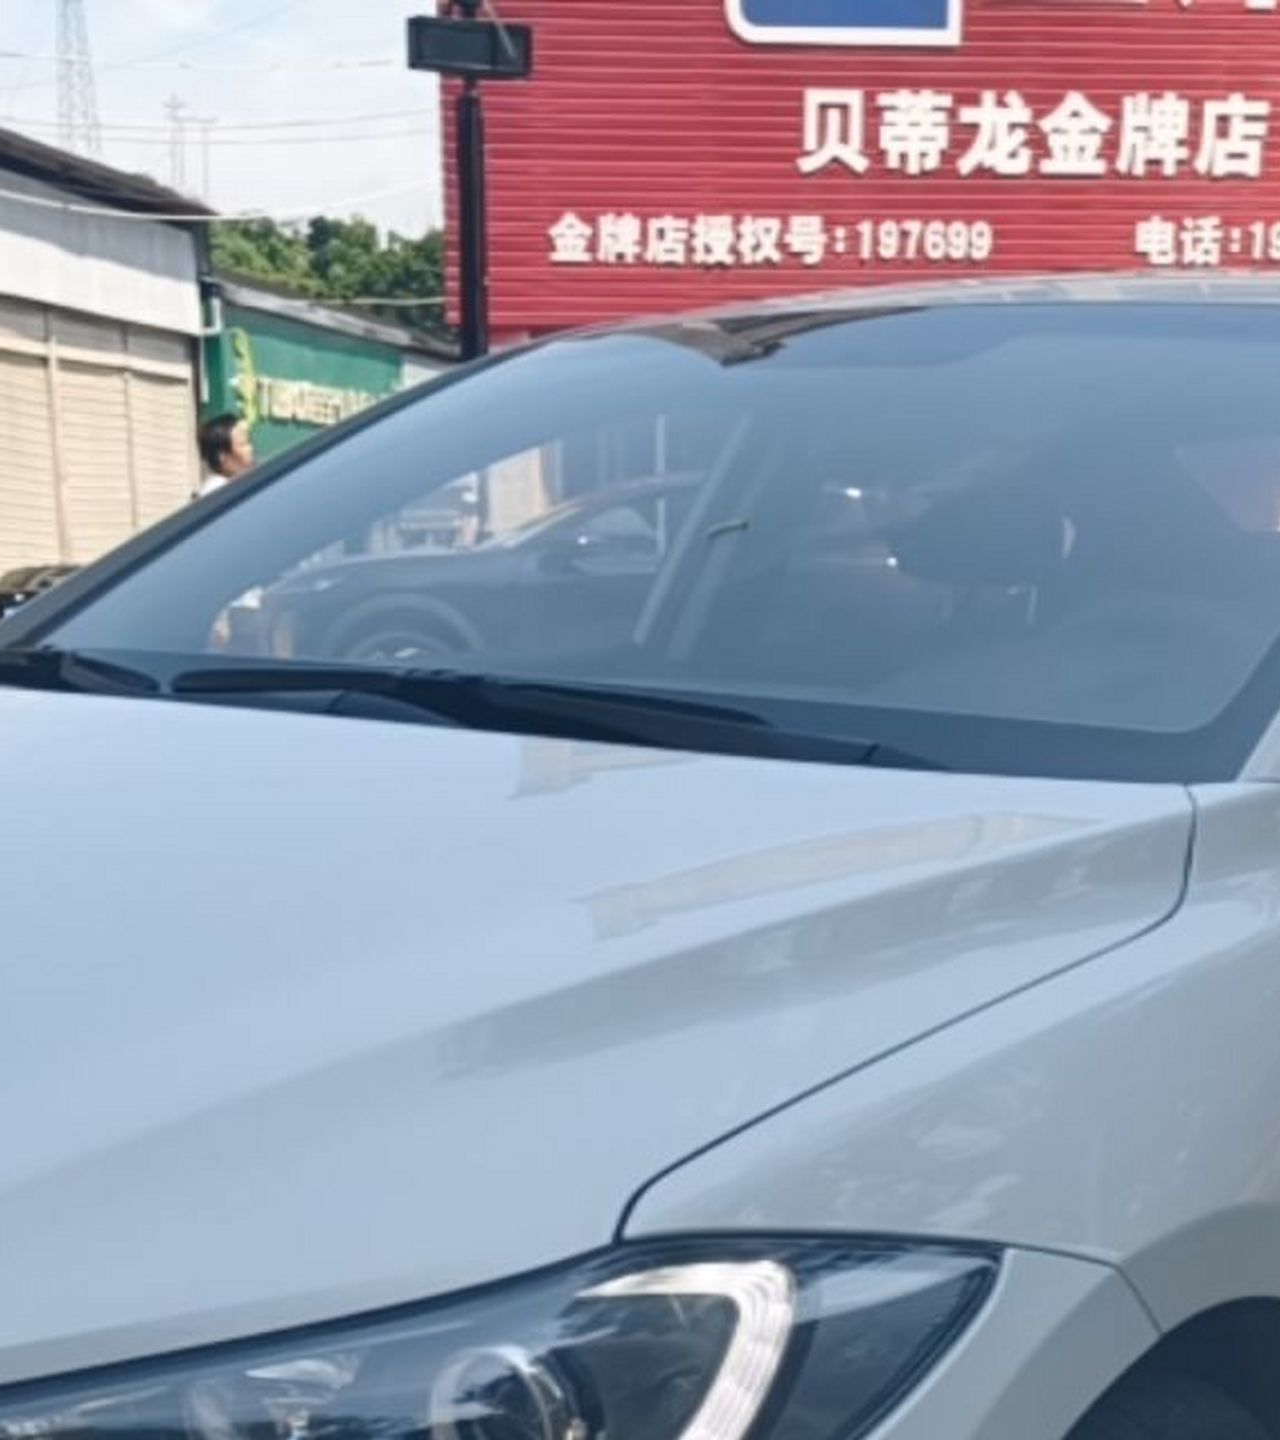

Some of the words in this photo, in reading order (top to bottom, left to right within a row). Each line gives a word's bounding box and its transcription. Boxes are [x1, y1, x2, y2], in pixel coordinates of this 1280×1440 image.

[797, 86, 1272, 178] 贝蒂龙金牌店
[547, 211, 994, 265] 金牌店授权号:197699
